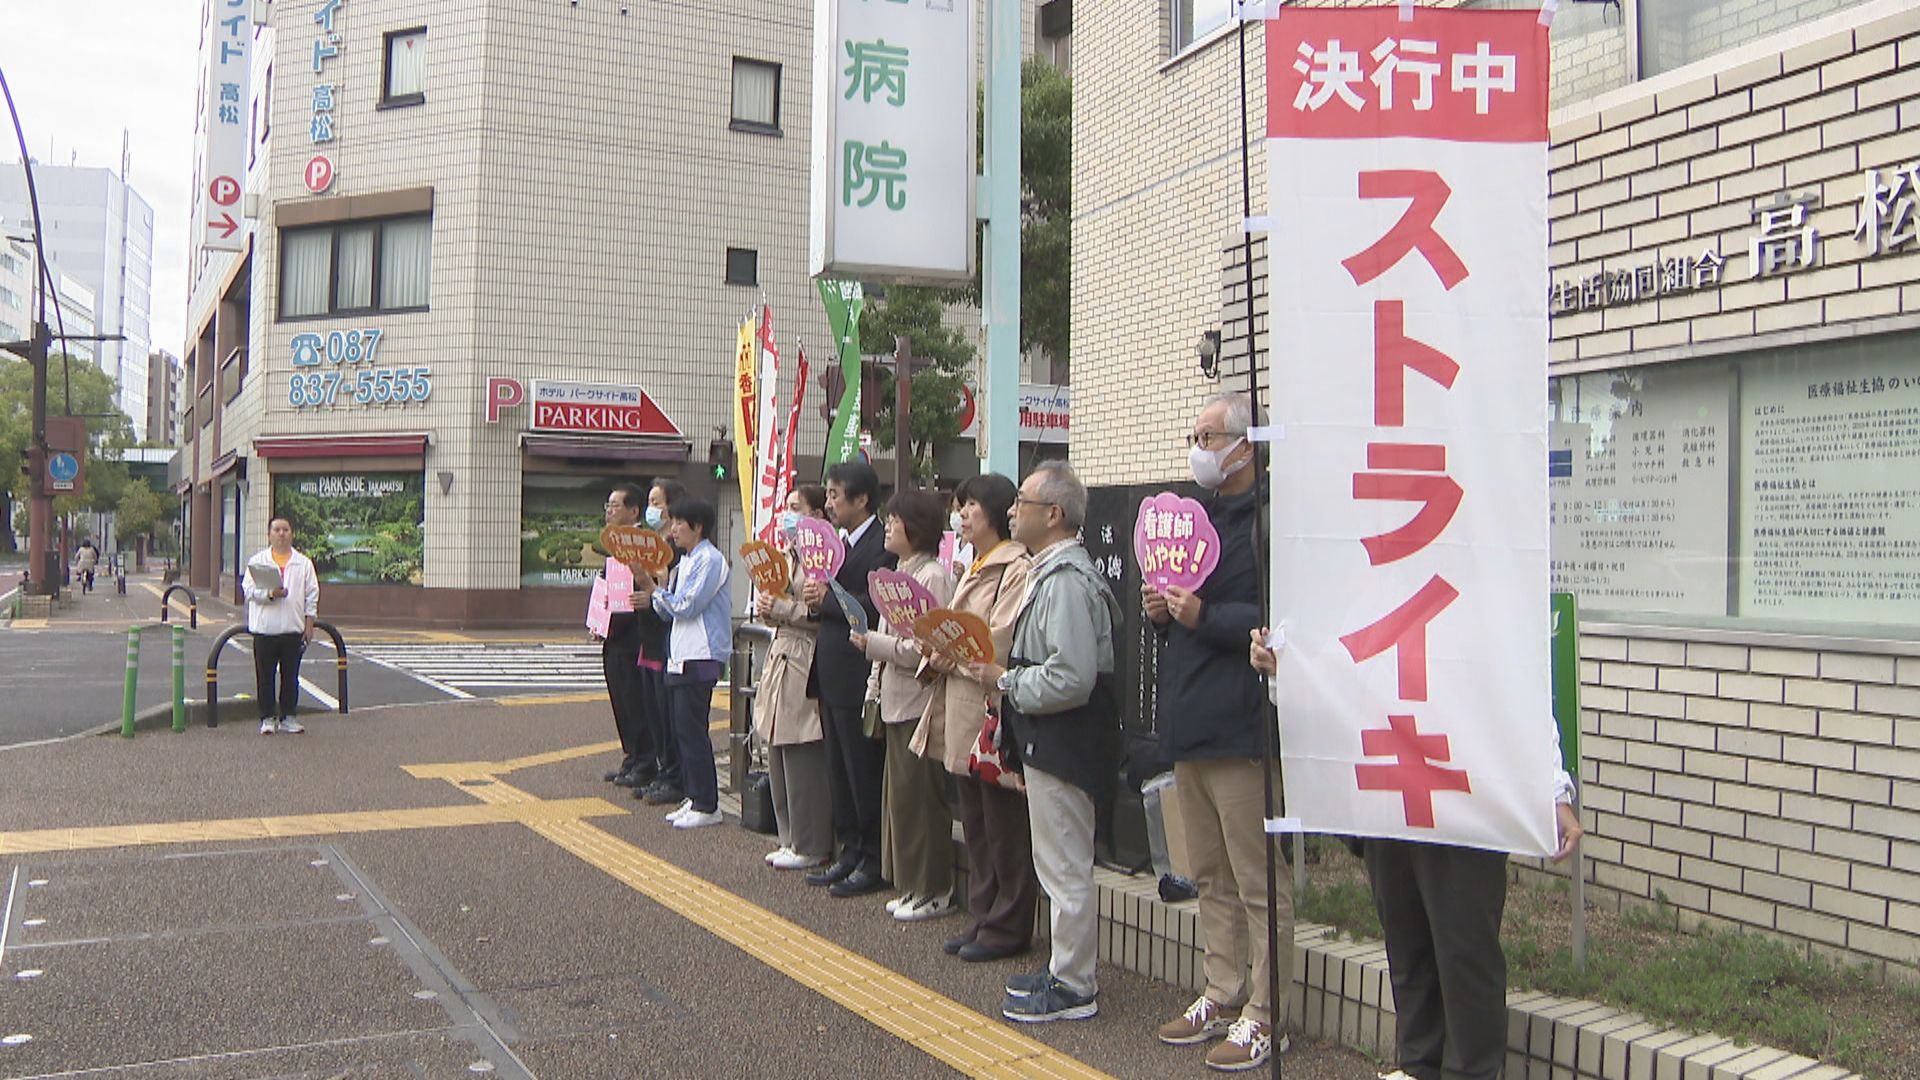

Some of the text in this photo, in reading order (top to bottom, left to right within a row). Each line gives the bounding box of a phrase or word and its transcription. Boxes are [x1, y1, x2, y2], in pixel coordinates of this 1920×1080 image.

[1292, 37, 1517, 114] 決行中
[218, 83, 240, 124] 高松
[310, 84, 333, 141] 高松
[1550, 248, 1727, 311] 生活協同組合
[326, 329, 383, 363] 087
[486, 376, 524, 424] P
[539, 388, 566, 398] ホテル
[1808, 375, 1920, 399] 医療福祉生協のい
[538, 405, 641, 429] PARKING
[1754, 405, 1785, 416] はじめに
[300, 481, 316, 493] HOTEL
[368, 480, 404, 492] TAKAMATSU
[1340, 168, 1471, 828] ストライキ
[1143, 506, 1194, 541] 看護師
